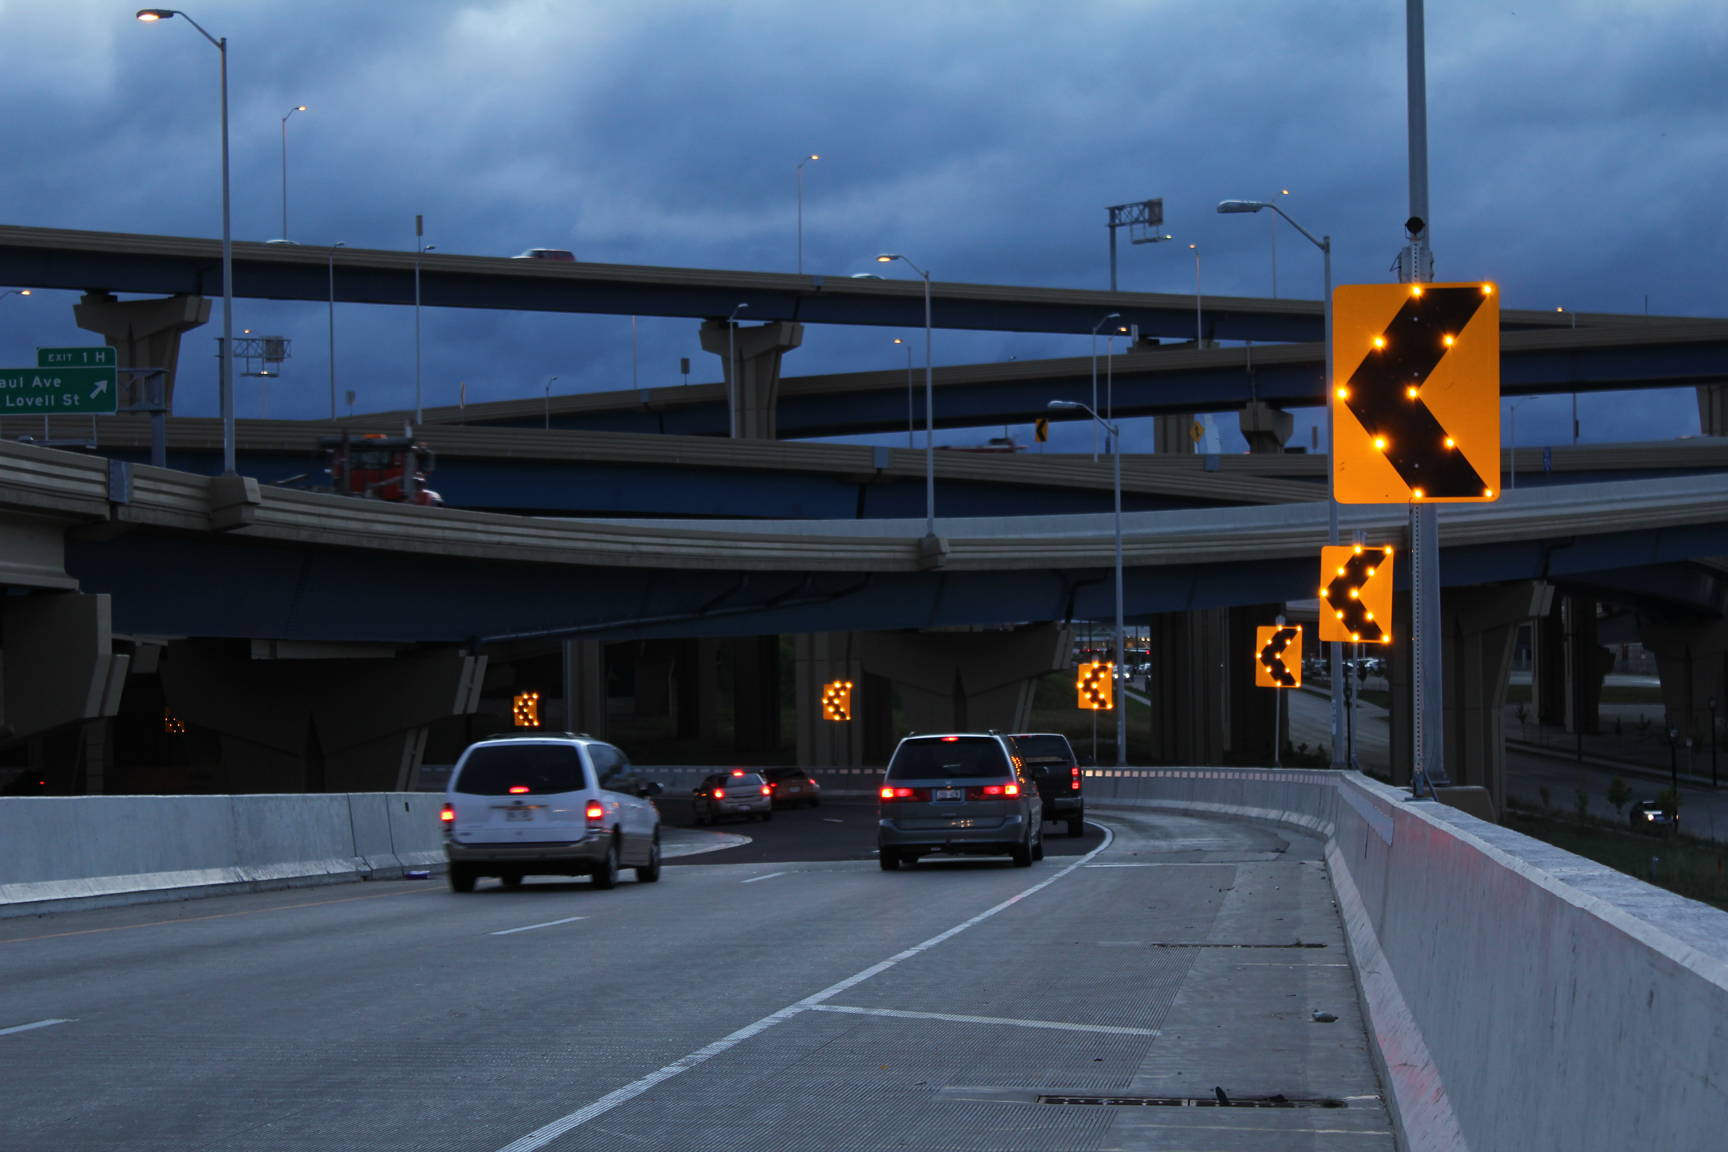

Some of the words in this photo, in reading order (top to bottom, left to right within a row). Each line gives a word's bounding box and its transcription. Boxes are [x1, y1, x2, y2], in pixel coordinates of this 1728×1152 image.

[48, 353, 72, 362] EXIT
[82, 352, 88, 363] 1
[95, 352, 105, 363] H
[31, 375, 62, 388] Ave
[6, 394, 55, 407] Lovell
[63, 393, 80, 406] St
